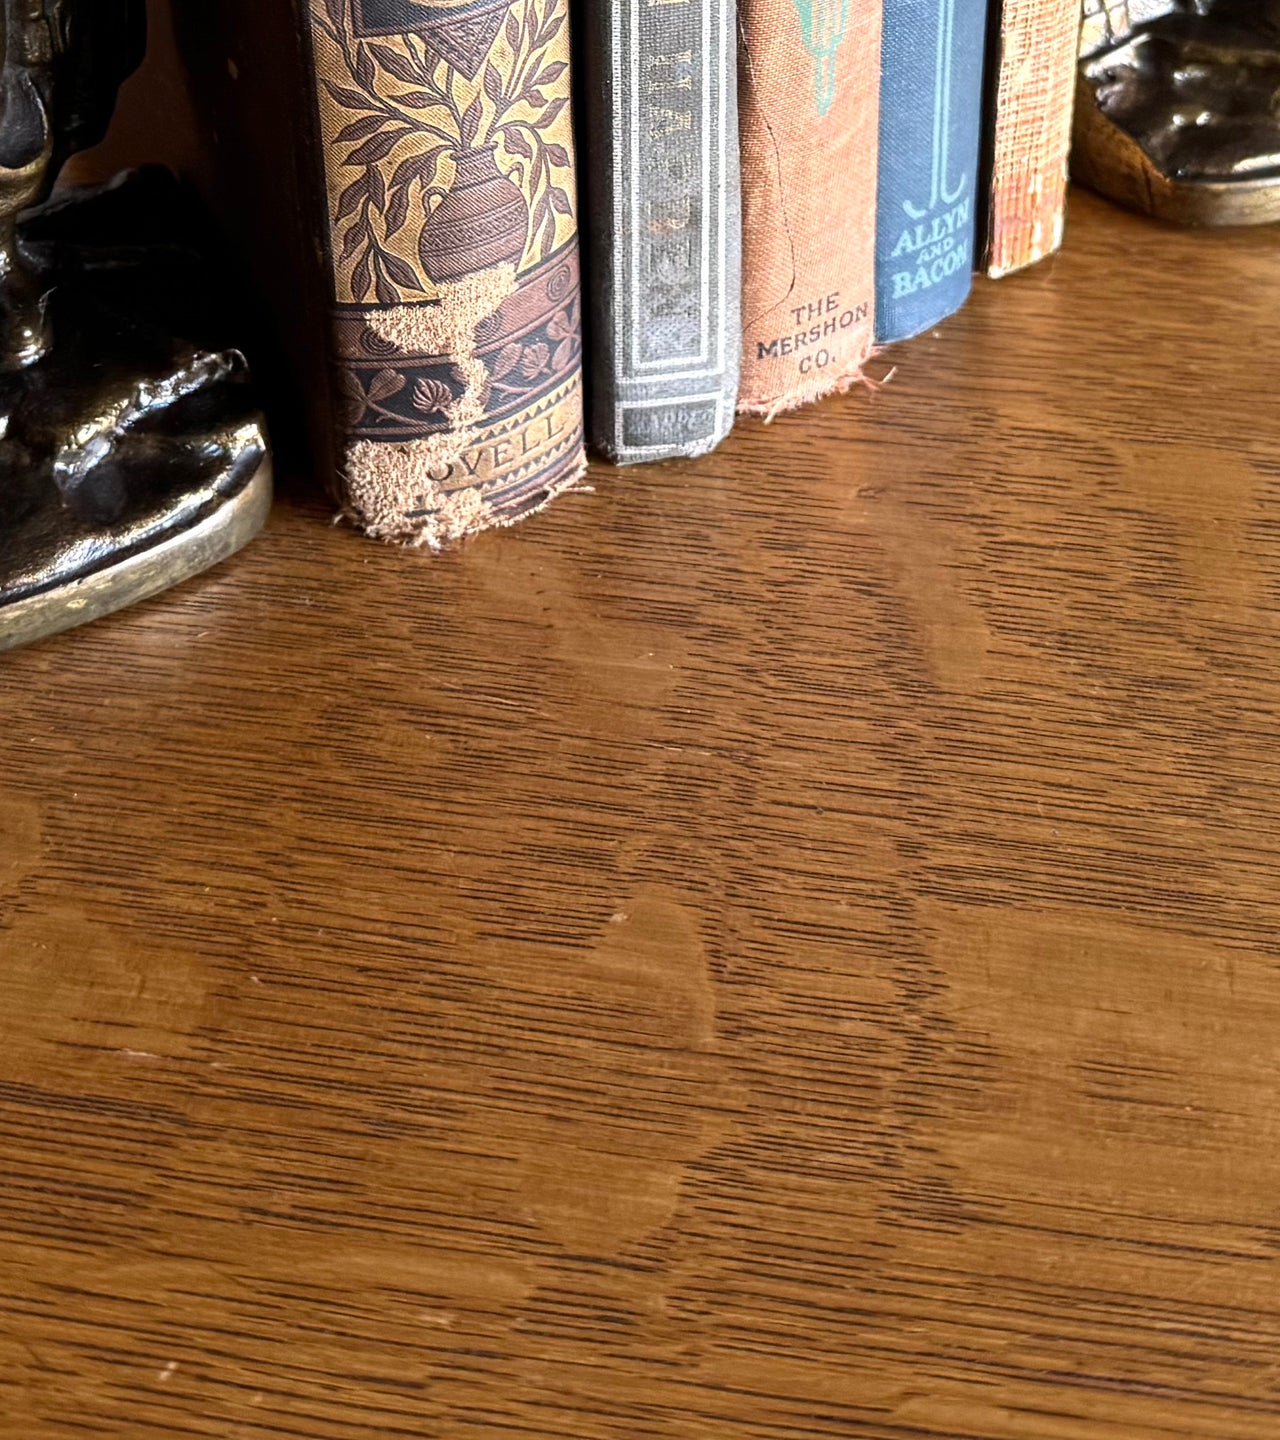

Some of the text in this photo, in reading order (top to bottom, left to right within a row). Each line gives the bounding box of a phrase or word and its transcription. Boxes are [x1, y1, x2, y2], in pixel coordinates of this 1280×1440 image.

[891, 197, 970, 258] ALLYN
[891, 239, 968, 300] BACON
[916, 237, 955, 265] AND
[756, 301, 869, 360] MERSHON
[791, 292, 840, 326] THE
[798, 349, 836, 375] CO.
